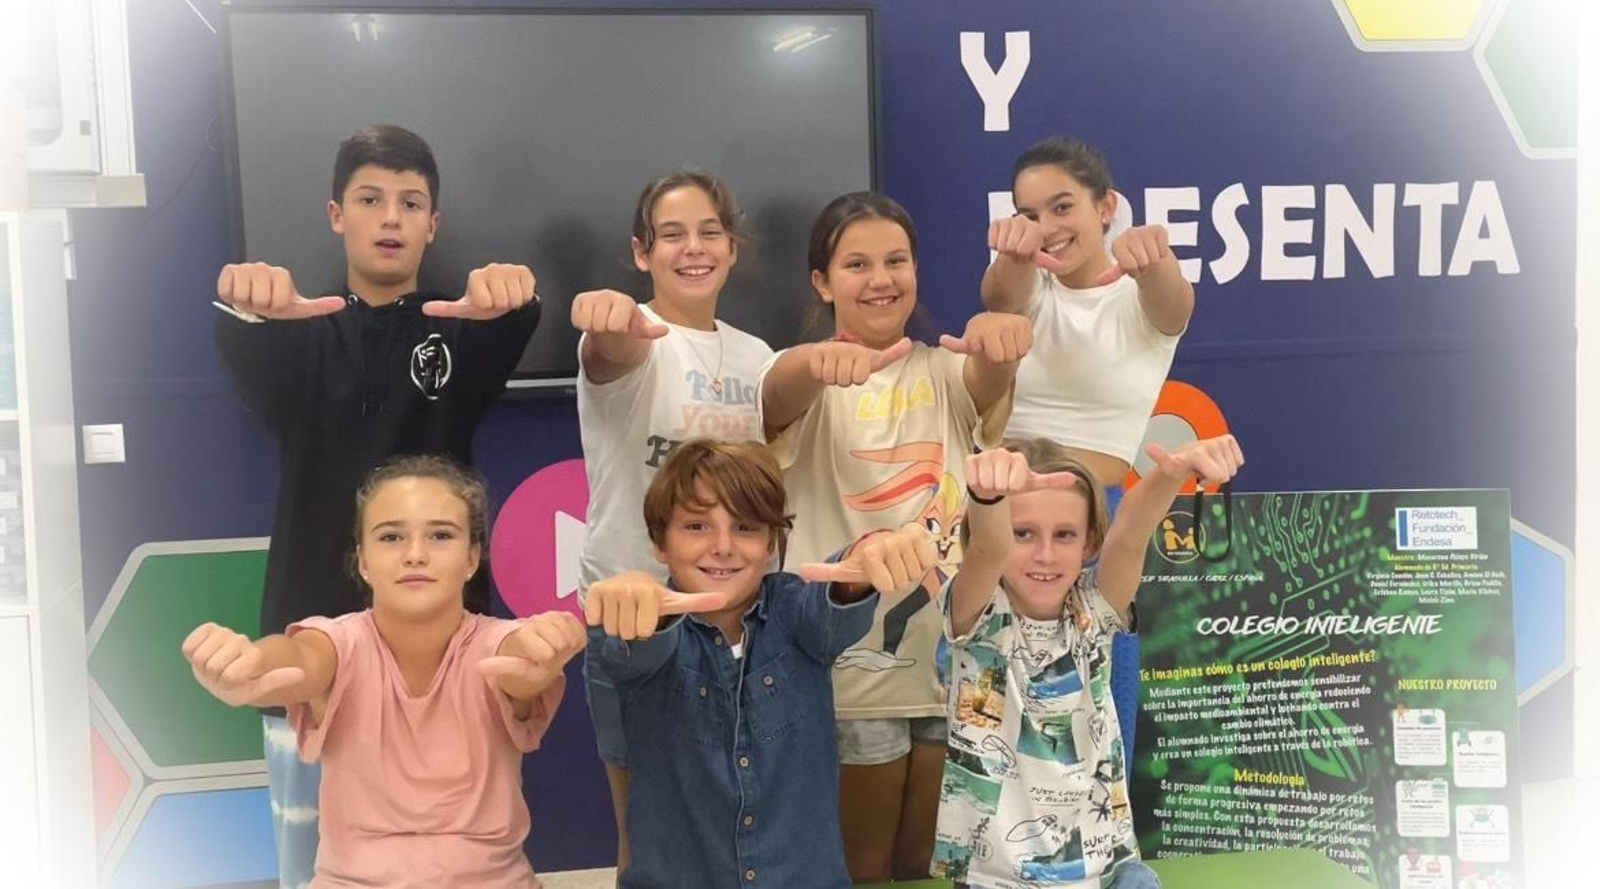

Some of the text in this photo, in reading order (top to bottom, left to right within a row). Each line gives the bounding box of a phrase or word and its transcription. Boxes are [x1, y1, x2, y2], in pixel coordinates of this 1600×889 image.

[960, 31, 1031, 132] Y
[988, 180, 1521, 285] ESENTA
[1413, 537, 1453, 546] Endesa
[1197, 614, 1443, 635] COLEGIO INTELIGENTE
[1139, 649, 1376, 681] Te imaginas cómo es un colegio inteligente?
[1149, 673, 1361, 698] Mediante este proyecto pretendemos sensibilizar
[1398, 679, 1497, 690] NUESTRO PROYECTO
[1143, 701, 1165, 711] sobre
[1167, 700, 1176, 709] la
[1177, 695, 1230, 709] importancia
[1232, 694, 1245, 704] del
[1246, 691, 1277, 703] ahorro
[1279, 690, 1288, 700] de
[1324, 685, 1371, 697] reduciendo
[1154, 713, 1162, 723] el
[1163, 711, 1198, 723] impacto
[1270, 706, 1276, 715] y
[1278, 702, 1317, 713] luchando
[1319, 699, 1350, 710] contra
[1351, 698, 1360, 708] el
[1157, 737, 1165, 747] El
[1167, 734, 1209, 746] alumnado
[1210, 732, 1251, 743] investiga
[1253, 730, 1277, 740] sobre
[1279, 728, 1287, 738] el
[1288, 726, 1319, 738] ahorro
[1321, 725, 1330, 735] de
[1221, 719, 1252, 730] cambio
[1152, 752, 1158, 760] y
[1160, 750, 1180, 759] crea
[1181, 749, 1192, 758] un
[1194, 747, 1223, 758] colegio
[1224, 744, 1273, 756] inteligente
[1274, 744, 1282, 752] a
[1311, 739, 1321, 749] de
[1160, 779, 1374, 805] Se propone una dinámica de trabajo por retos
[1165, 795, 1365, 818] de forma progresiva empezando por retos
[1161, 820, 1171, 831] la
[1244, 826, 1253, 837] la
[1305, 831, 1316, 842] de
[1213, 810, 1231, 822] Con
[1234, 813, 1255, 824] esta
[1257, 816, 1306, 828] propuesta
[1308, 818, 1377, 832] desarrollamos
[1162, 834, 1171, 845] la
[1233, 839, 1242, 850] la
[1329, 847, 1366, 861] trabajo
